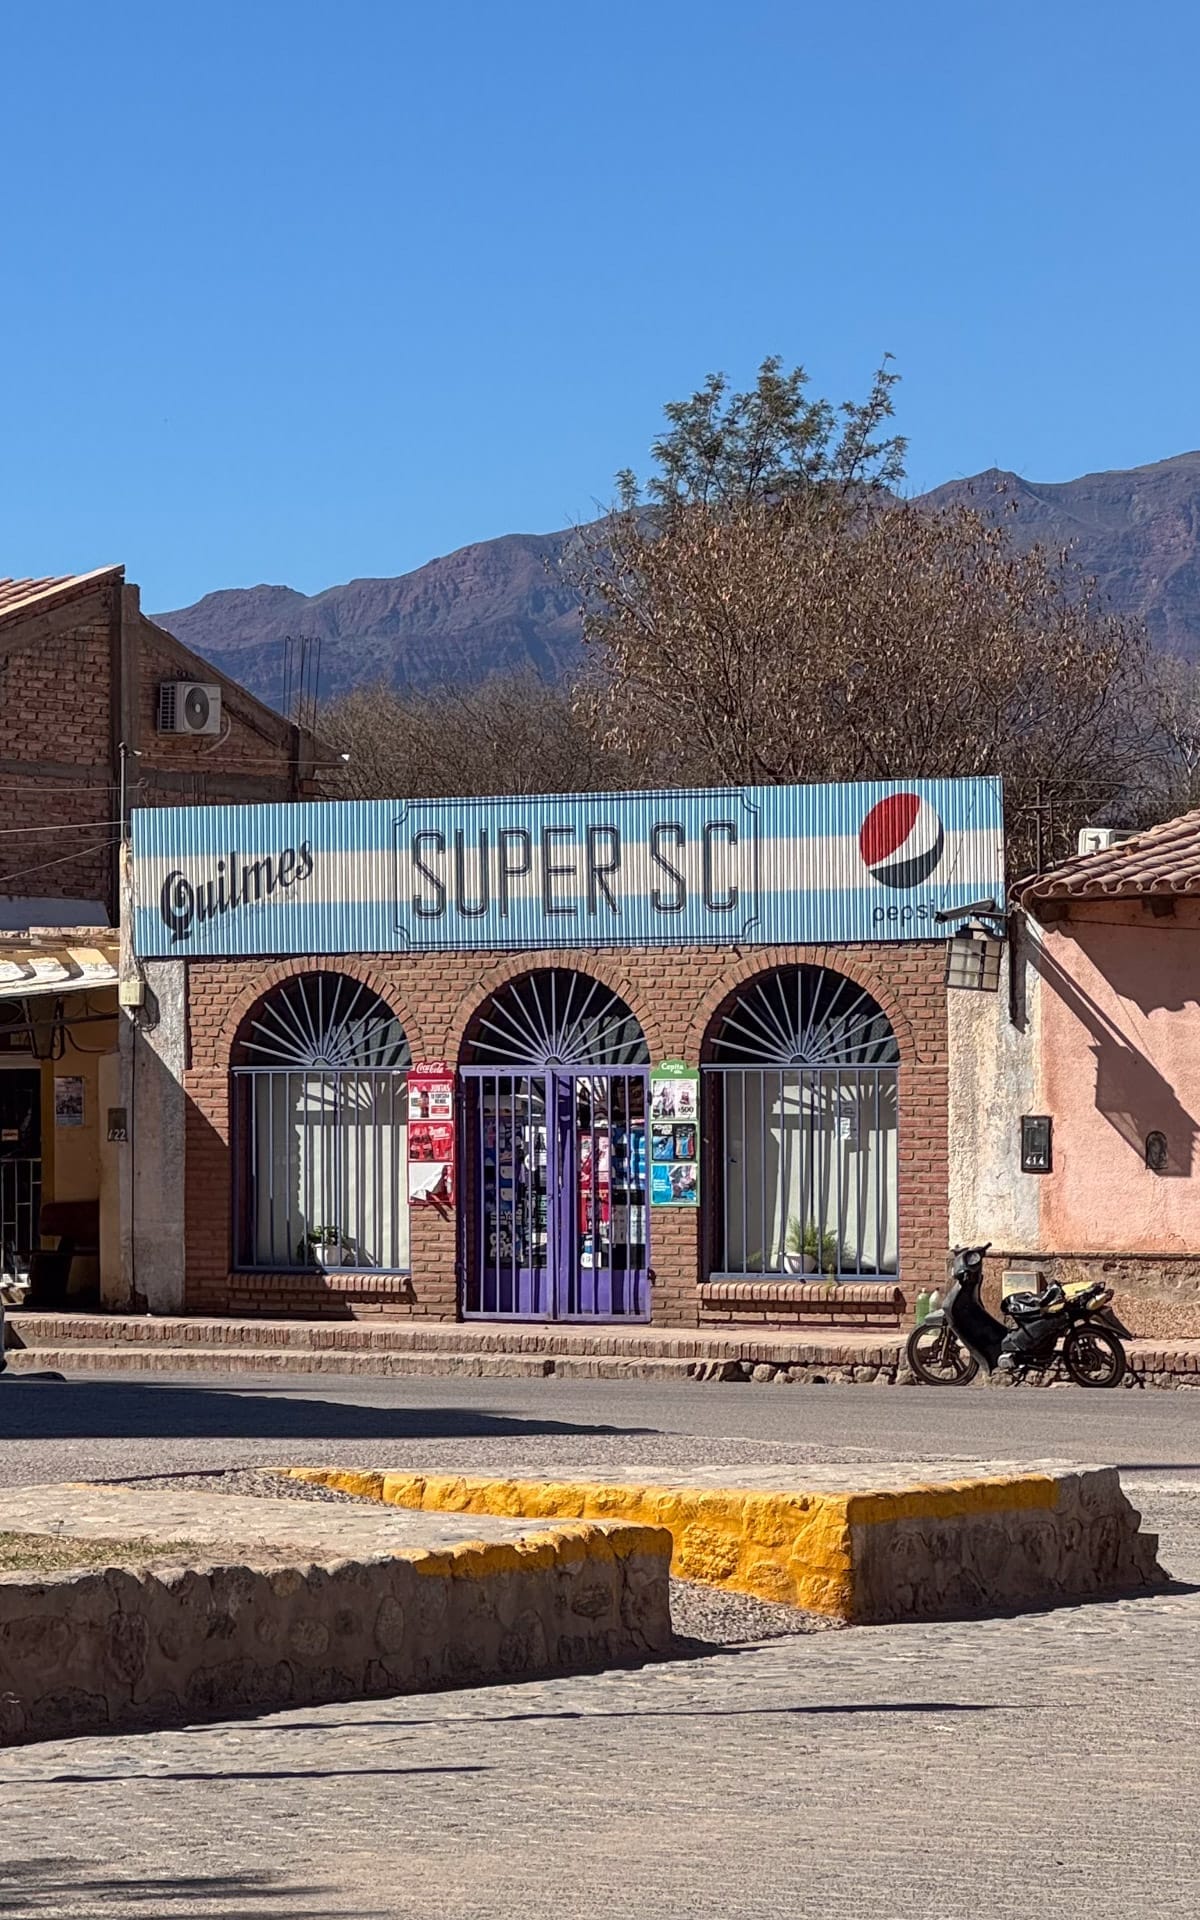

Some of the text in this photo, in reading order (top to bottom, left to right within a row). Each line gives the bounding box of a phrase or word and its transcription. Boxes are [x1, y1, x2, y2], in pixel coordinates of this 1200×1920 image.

[161, 840, 313, 944] Quilmes
[412, 823, 622, 919] SUPER
[872, 899, 935, 928] pepsi
